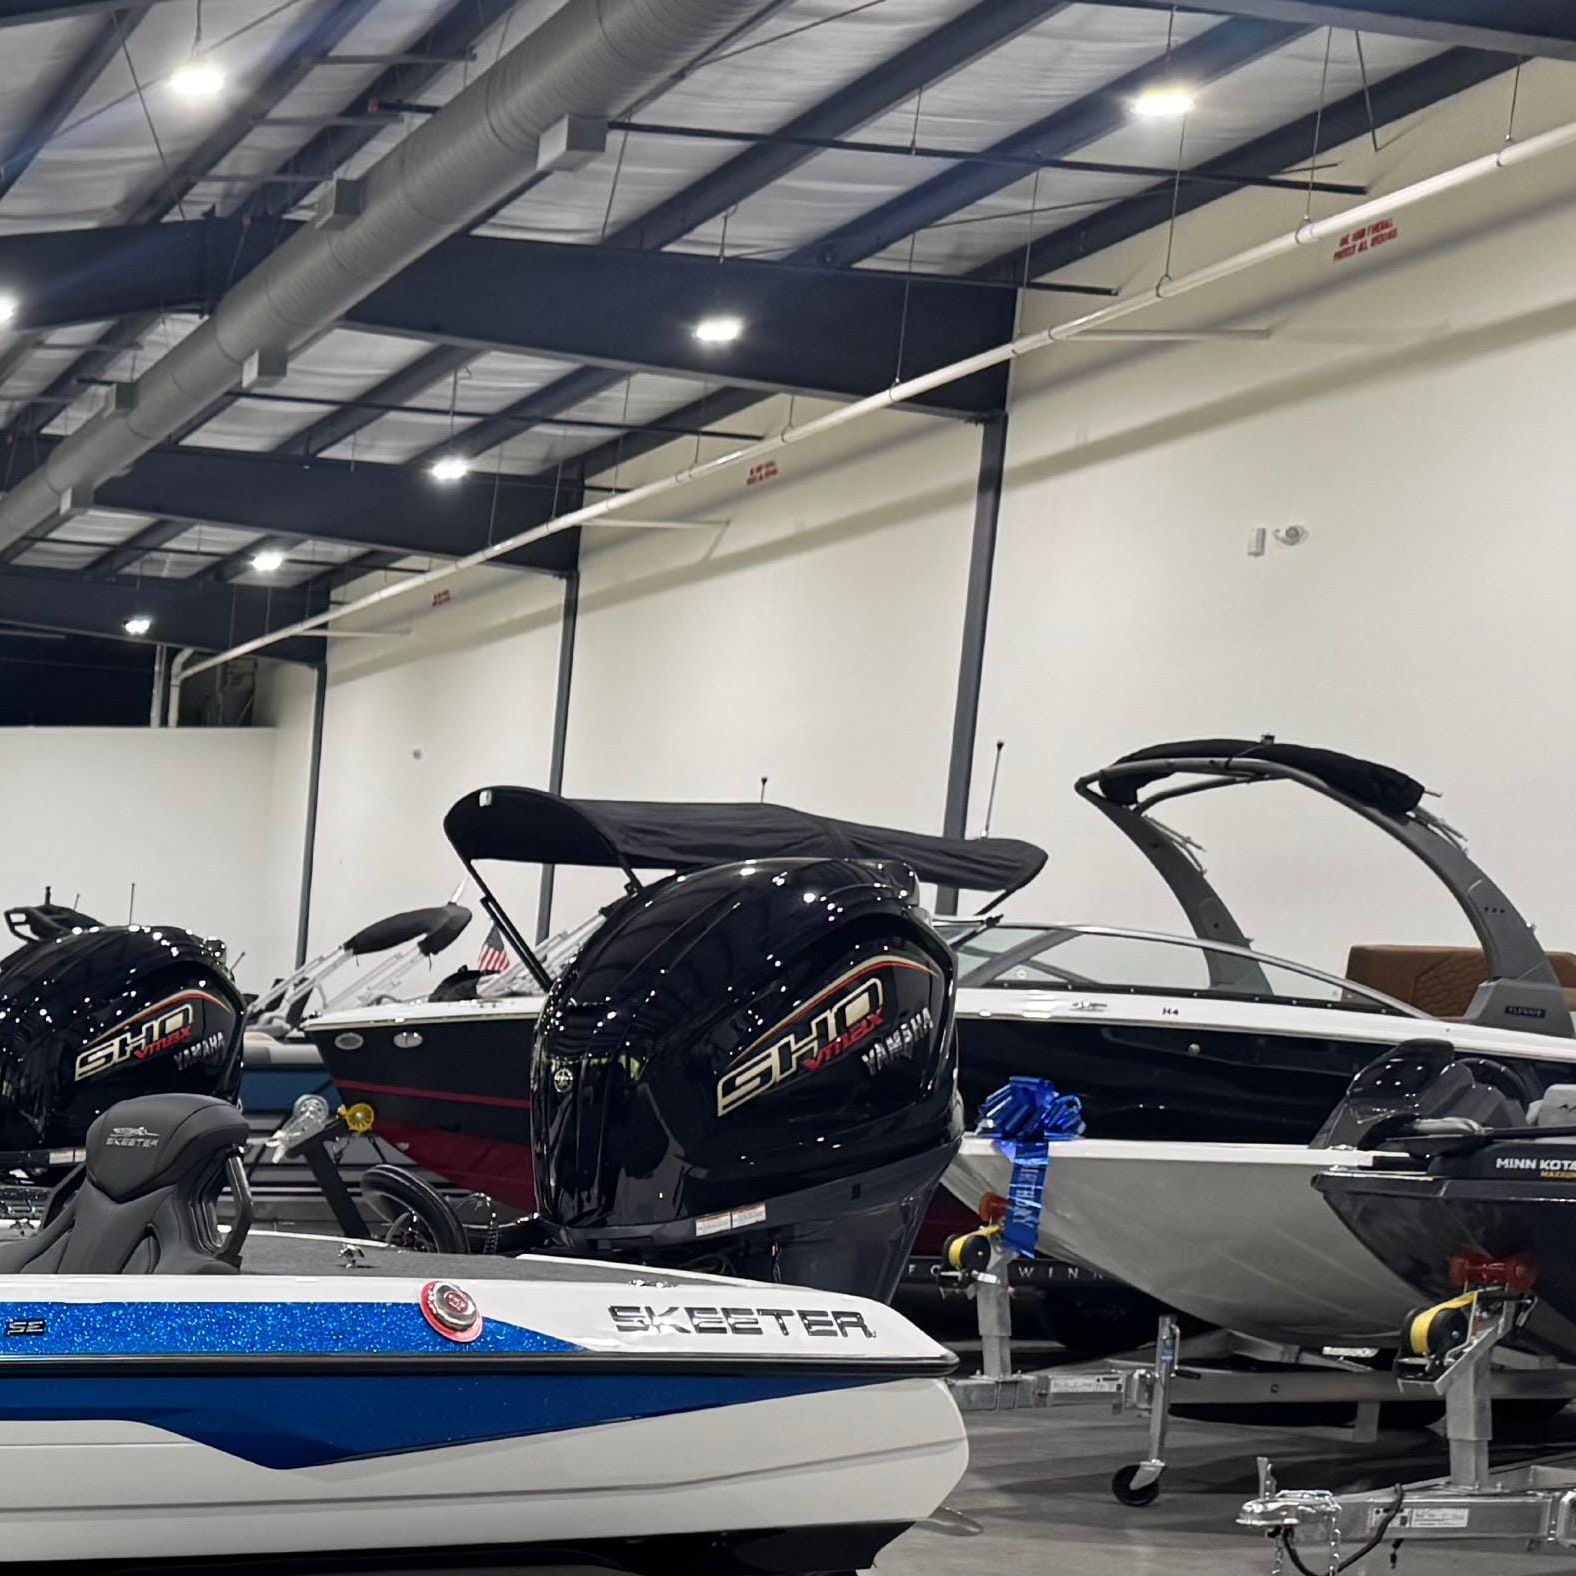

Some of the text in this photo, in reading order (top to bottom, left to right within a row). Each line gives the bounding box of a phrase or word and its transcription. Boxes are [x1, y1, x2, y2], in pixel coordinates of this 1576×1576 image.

[74, 1004, 194, 1081] SHO
[173, 1032, 225, 1071] YAMAHA
[717, 977, 883, 1117] SHO
[861, 1007, 934, 1076] YAMAHA
[1495, 1158, 1537, 1169] MINN
[7, 1318, 46, 1336] SE
[608, 1306, 871, 1338] SKEETER
